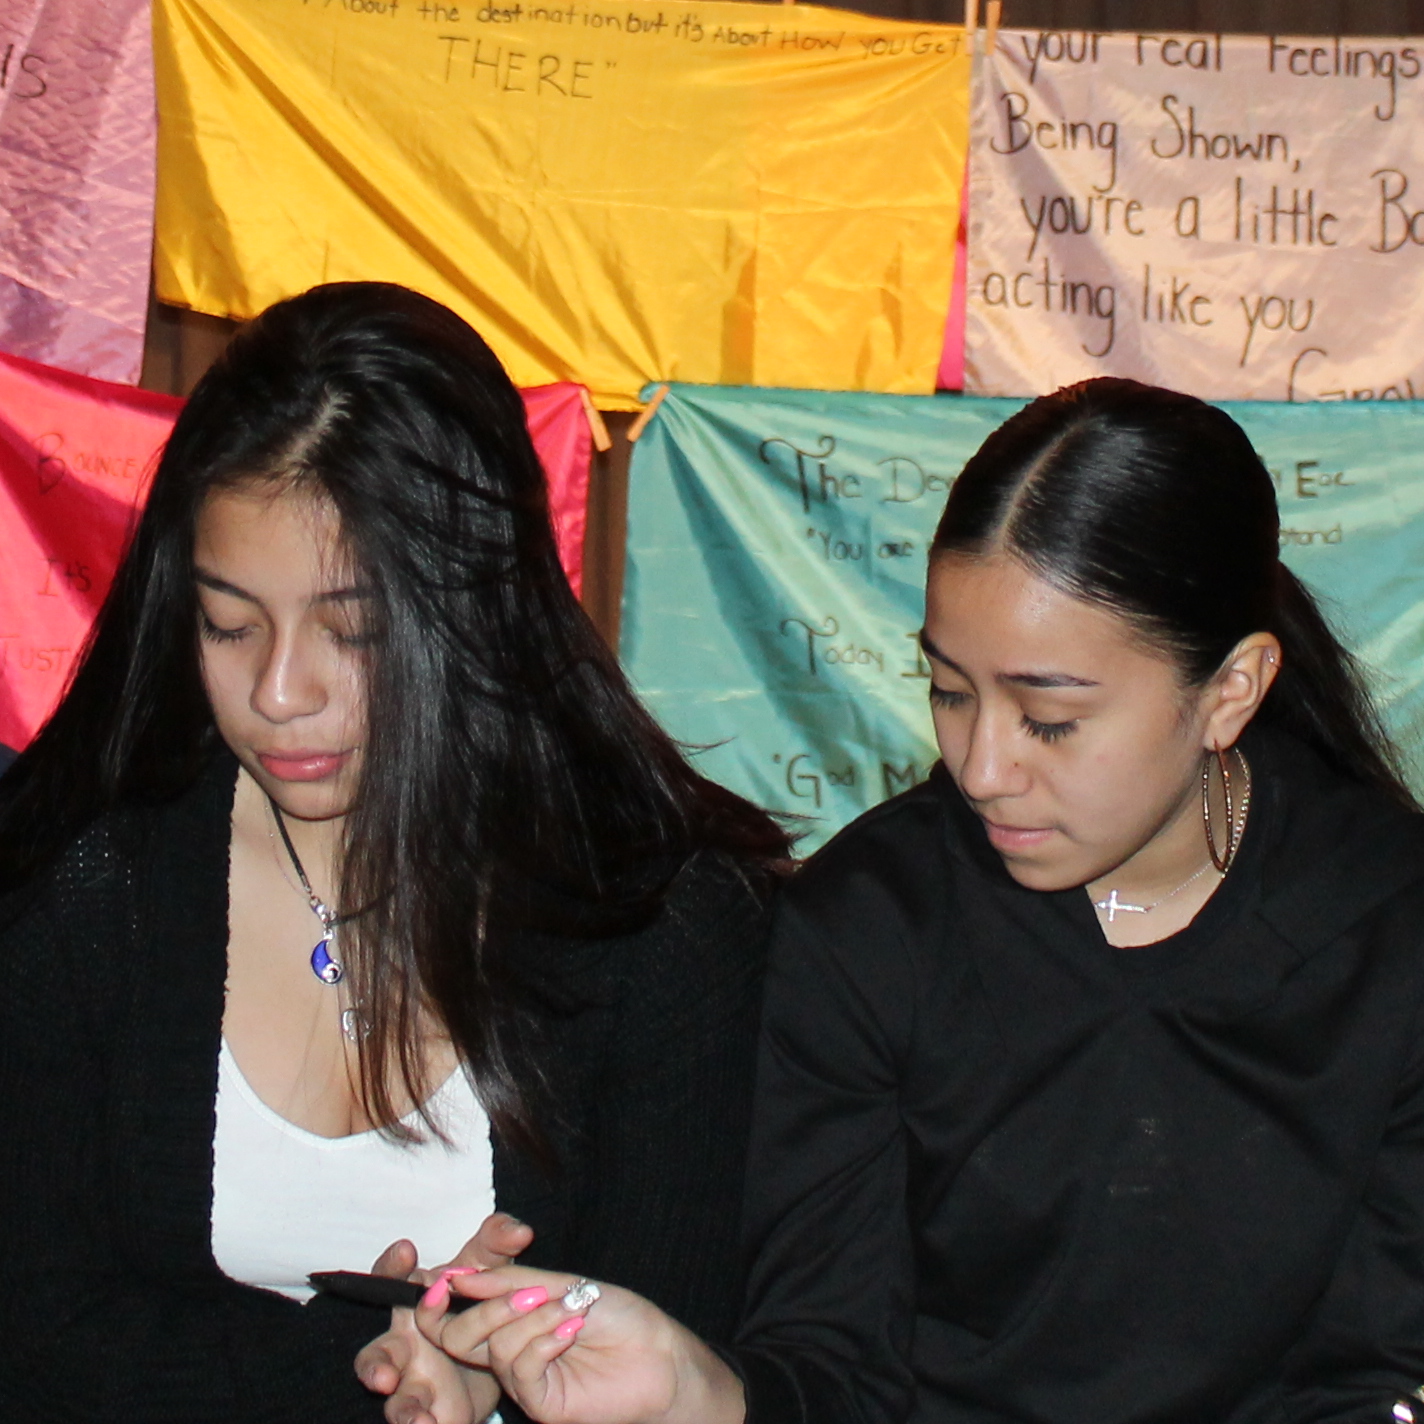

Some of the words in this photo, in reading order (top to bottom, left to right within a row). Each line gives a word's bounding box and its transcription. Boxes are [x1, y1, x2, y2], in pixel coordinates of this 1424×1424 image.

[416, 0, 461, 23] the
[626, 11, 669, 34] but
[711, 24, 773, 48] About
[990, 92, 1118, 193] Being
[1150, 94, 1303, 174] Shown,
[1175, 194, 1201, 238] a
[1234, 176, 1339, 249] little
[980, 257, 1117, 358] acting
[1141, 264, 1214, 329] like
[1237, 291, 1316, 369] you
[759, 434, 863, 514] The
[779, 616, 885, 676] Today
